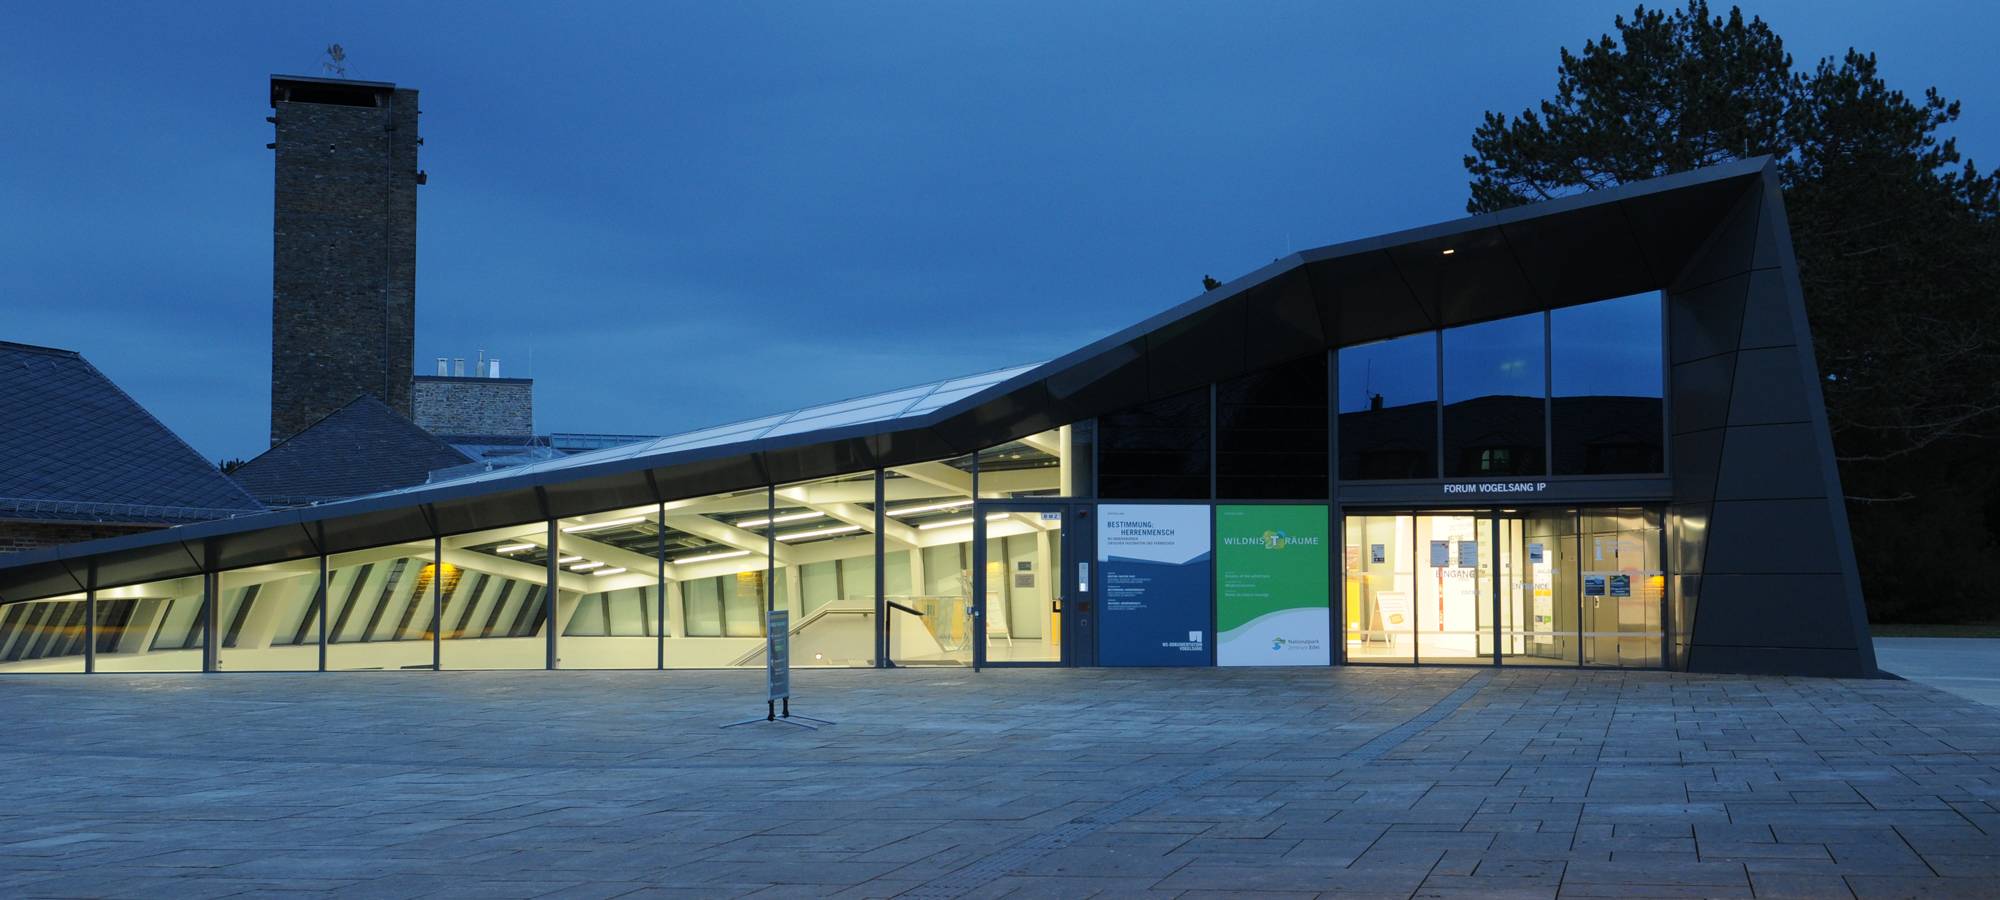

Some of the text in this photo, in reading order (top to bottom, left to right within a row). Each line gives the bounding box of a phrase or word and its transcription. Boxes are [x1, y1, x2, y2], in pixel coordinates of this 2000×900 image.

[1444, 482, 1547, 493] FORUM VOGELSANG IP
